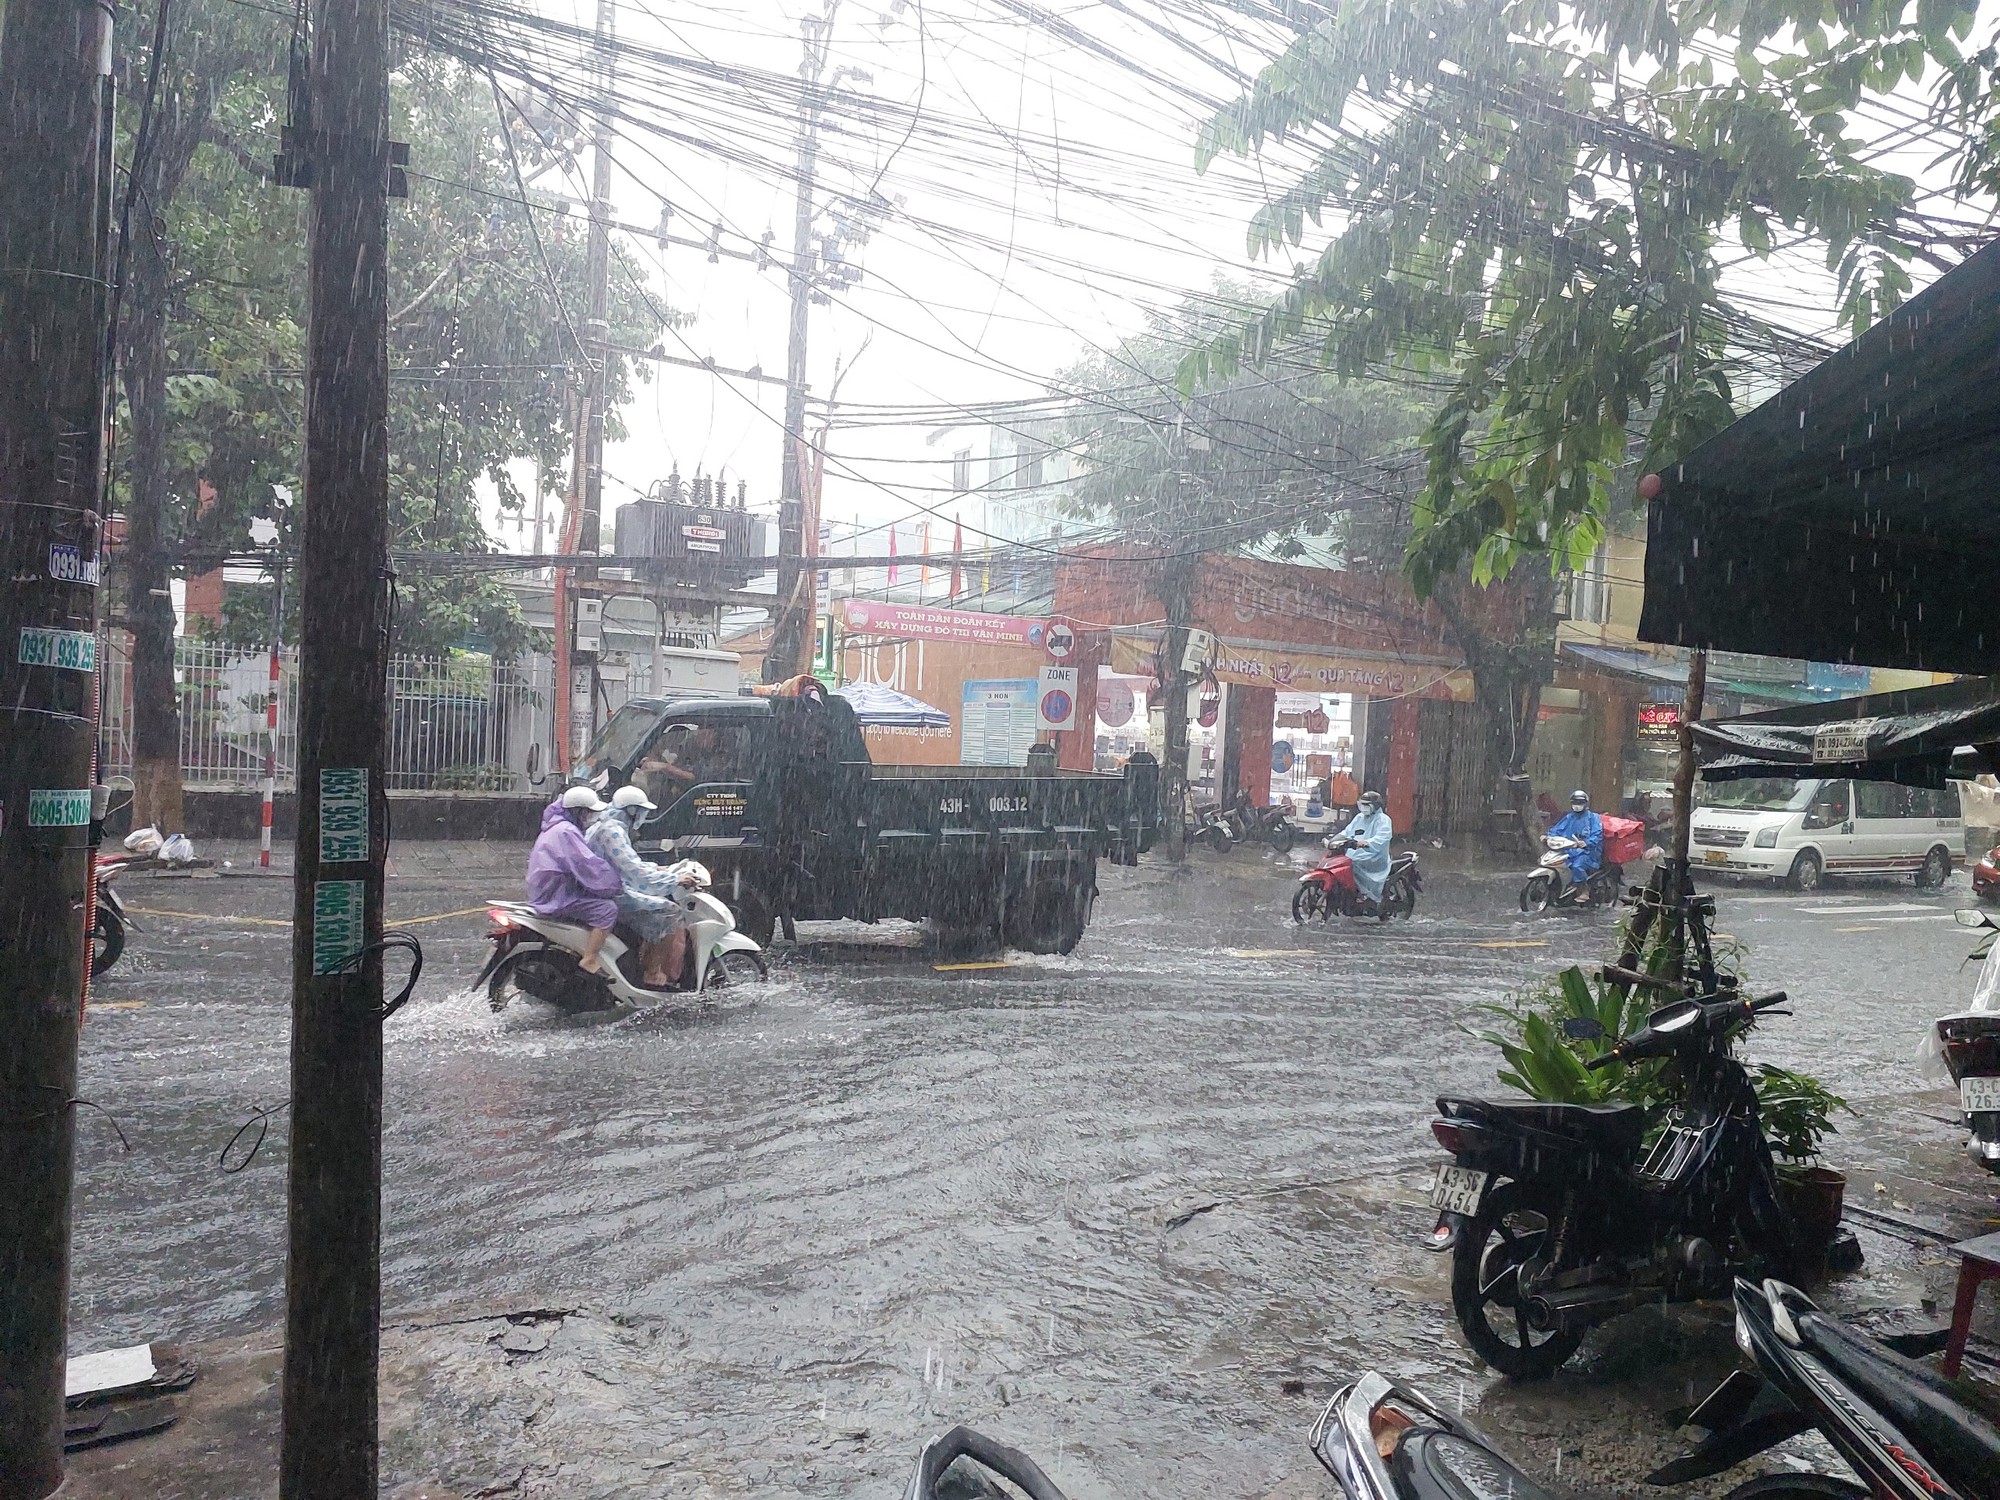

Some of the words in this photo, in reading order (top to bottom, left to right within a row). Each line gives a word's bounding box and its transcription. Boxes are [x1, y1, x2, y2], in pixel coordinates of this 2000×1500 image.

[996, 632, 1023, 642] MINH
[1047, 669, 1071, 681] ZONE
[989, 796, 1028, 812] 003.12
[1435, 1188, 1472, 1214] 0454
[1796, 1356, 1892, 1446] JUPITER
